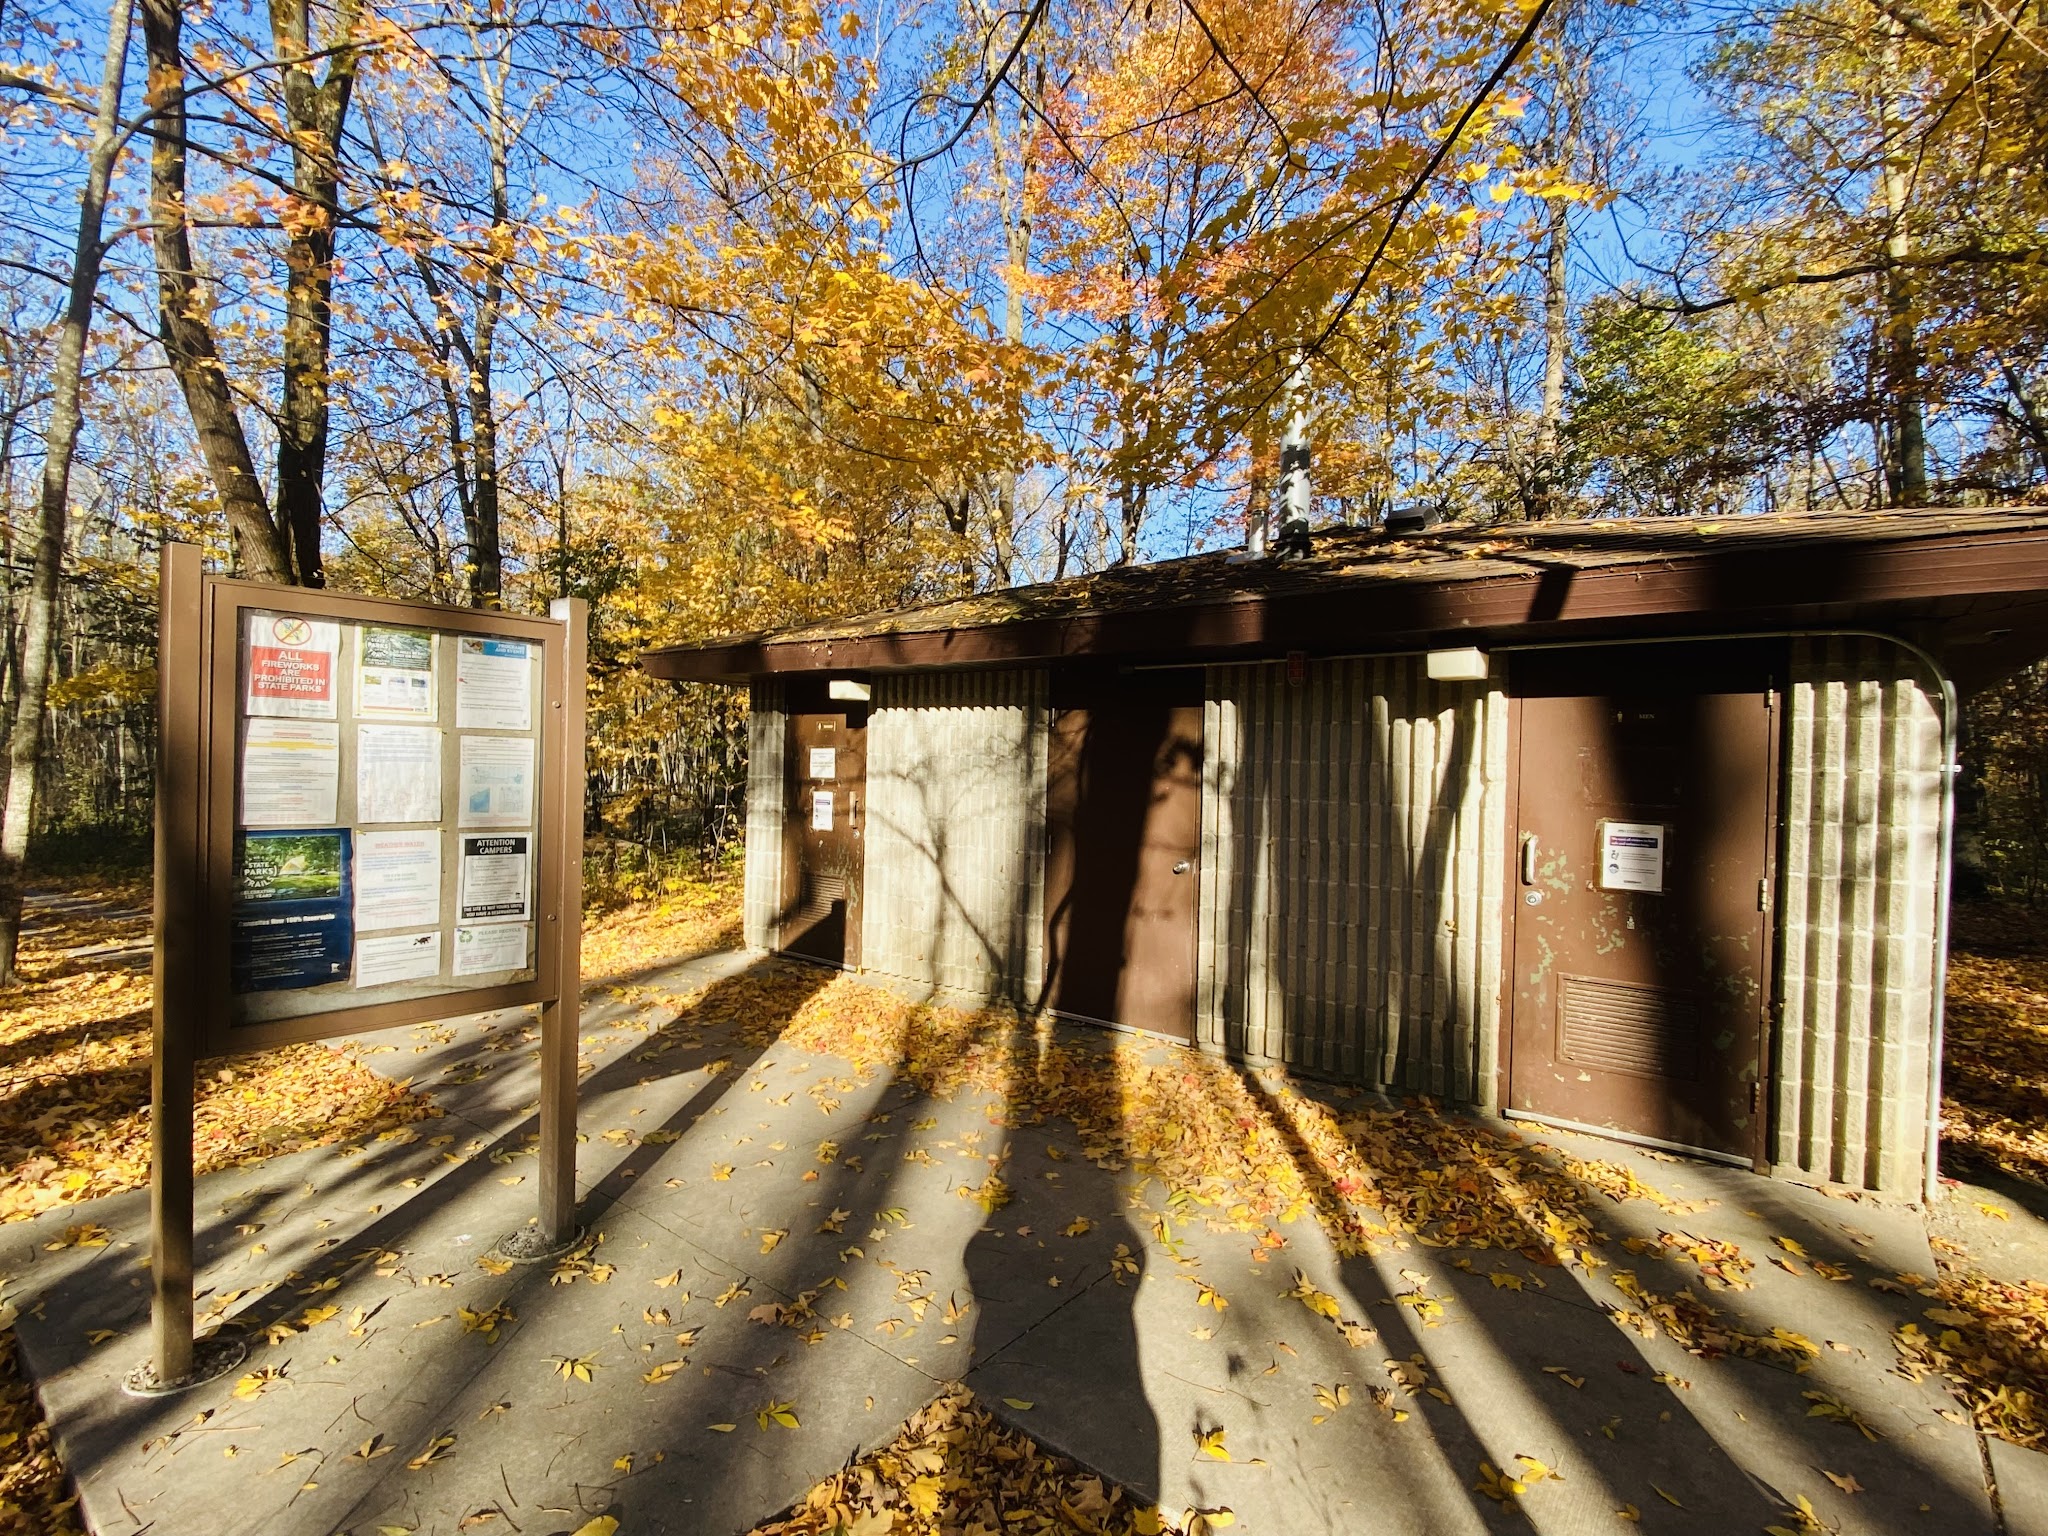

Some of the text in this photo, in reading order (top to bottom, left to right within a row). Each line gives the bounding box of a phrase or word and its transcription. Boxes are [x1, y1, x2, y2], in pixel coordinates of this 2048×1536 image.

[278, 650, 304, 661] ALL
[262, 660, 320, 671] FIREWORKS
[280, 669, 300, 677] ARE
[254, 674, 326, 686] PROHIBITED IN
[258, 682, 322, 692] STATE PARKS
[476, 838, 516, 847] ATTENTION
[480, 846, 512, 854] CAMPERS
[244, 876, 274, 888] TRAILS
